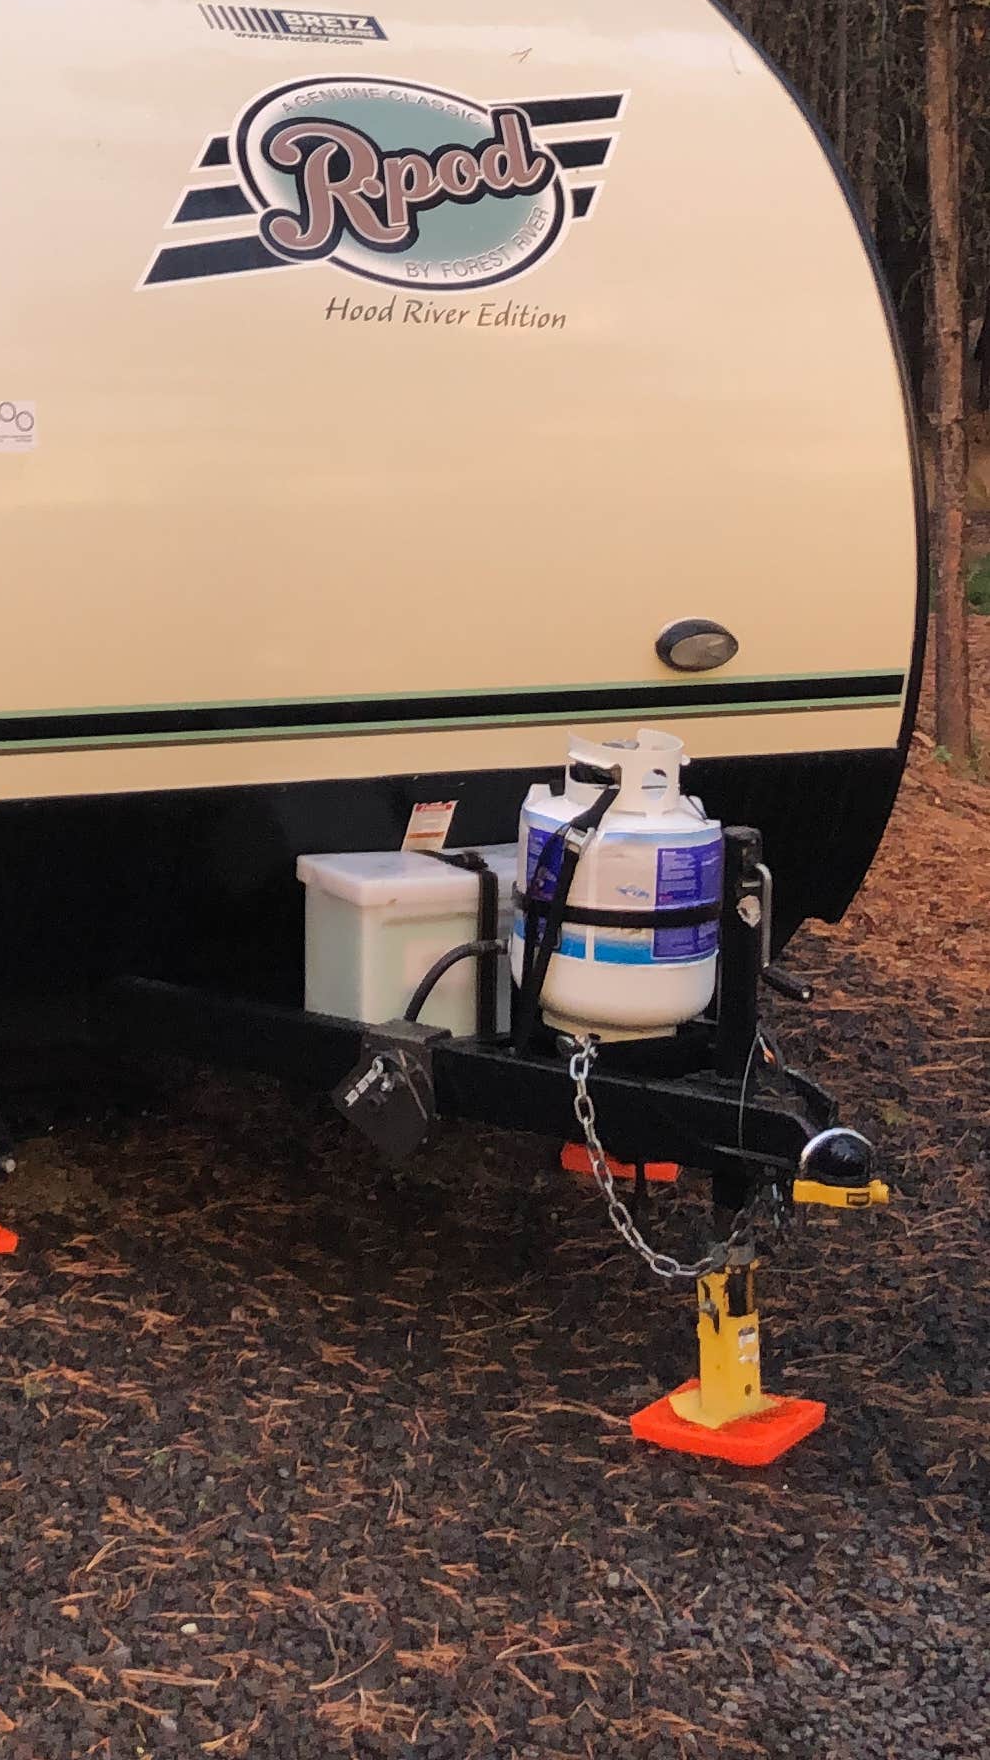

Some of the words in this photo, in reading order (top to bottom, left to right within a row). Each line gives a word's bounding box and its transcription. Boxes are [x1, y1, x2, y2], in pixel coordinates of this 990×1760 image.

[281, 12, 373, 30] BRETZ
[294, 87, 381, 108] GENUINE
[387, 90, 485, 125] CLASSIC
[405, 261, 434, 278] BY
[441, 243, 512, 278] FOREST
[512, 205, 550, 250] RIVER
[324, 295, 397, 323] Hood
[403, 299, 471, 325] River
[476, 300, 567, 329] Edition
